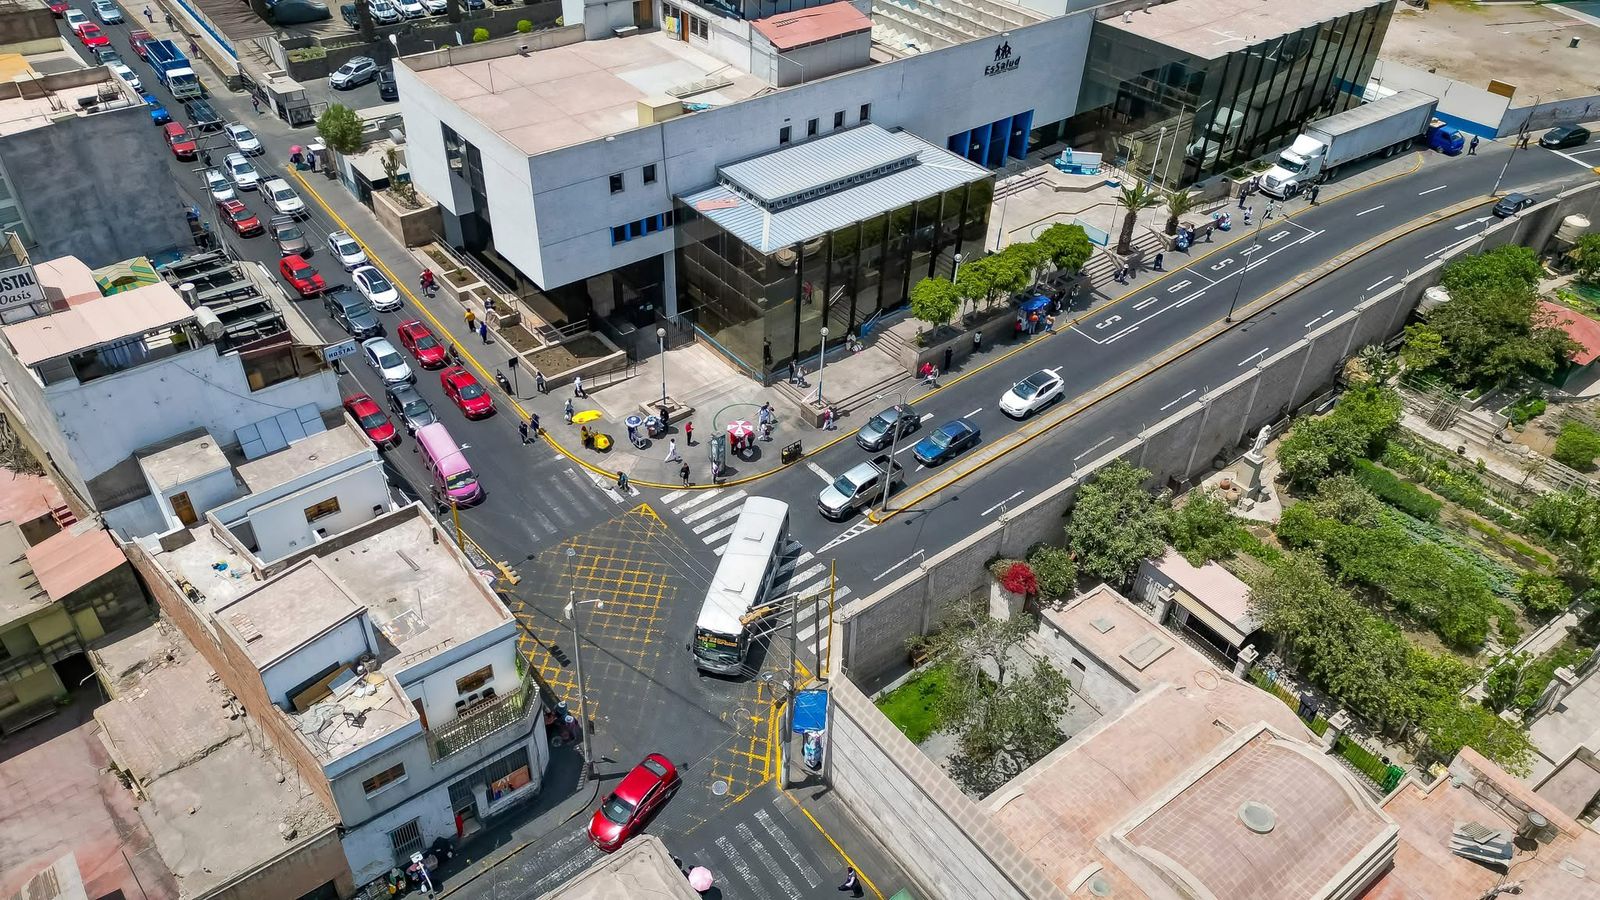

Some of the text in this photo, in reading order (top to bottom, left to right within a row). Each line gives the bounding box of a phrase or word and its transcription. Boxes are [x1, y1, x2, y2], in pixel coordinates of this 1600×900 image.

[984, 56, 1021, 76] EsSalud
[0, 290, 31, 305] Oasis
[328, 346, 355, 358] HOSTAL
